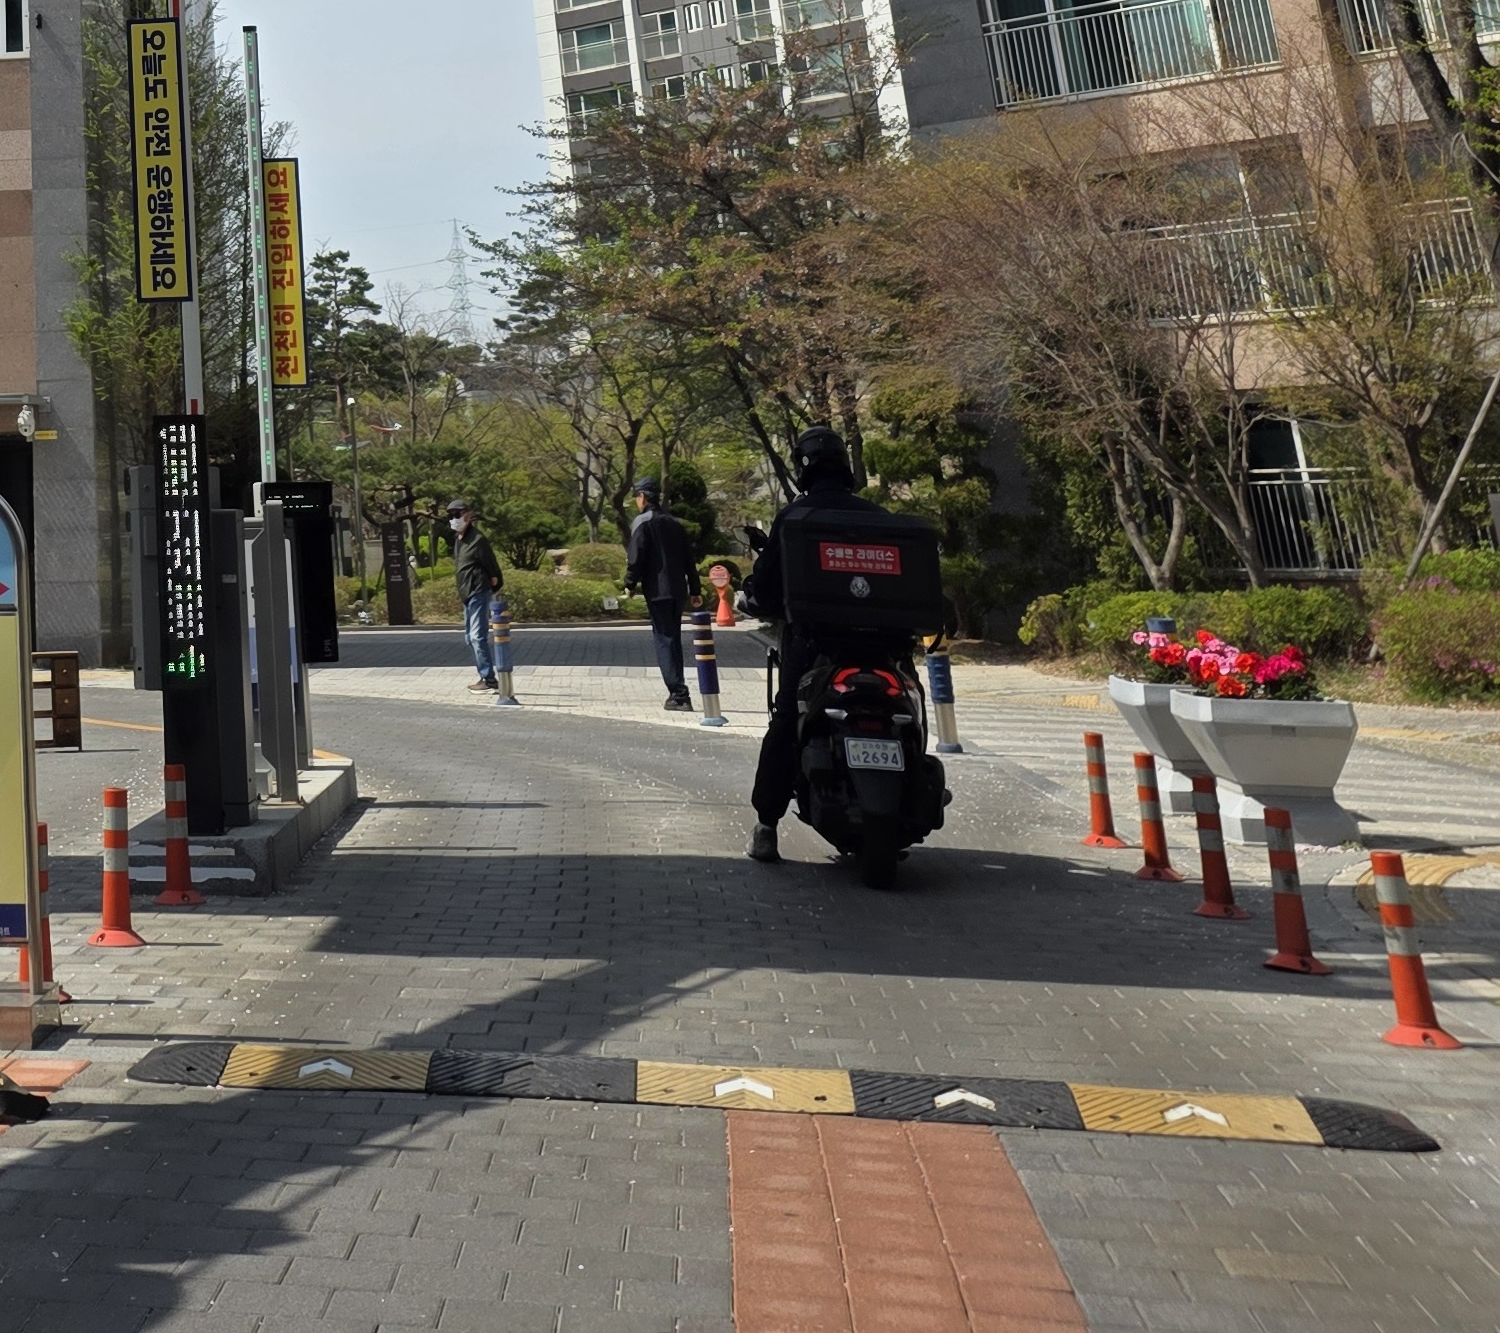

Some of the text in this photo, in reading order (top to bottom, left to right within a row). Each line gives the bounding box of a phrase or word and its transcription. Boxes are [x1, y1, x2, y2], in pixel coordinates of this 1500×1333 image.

[141, 28, 177, 292] 오늘도 안전 운행하세요
[267, 167, 299, 378] 천천히 진입하세요
